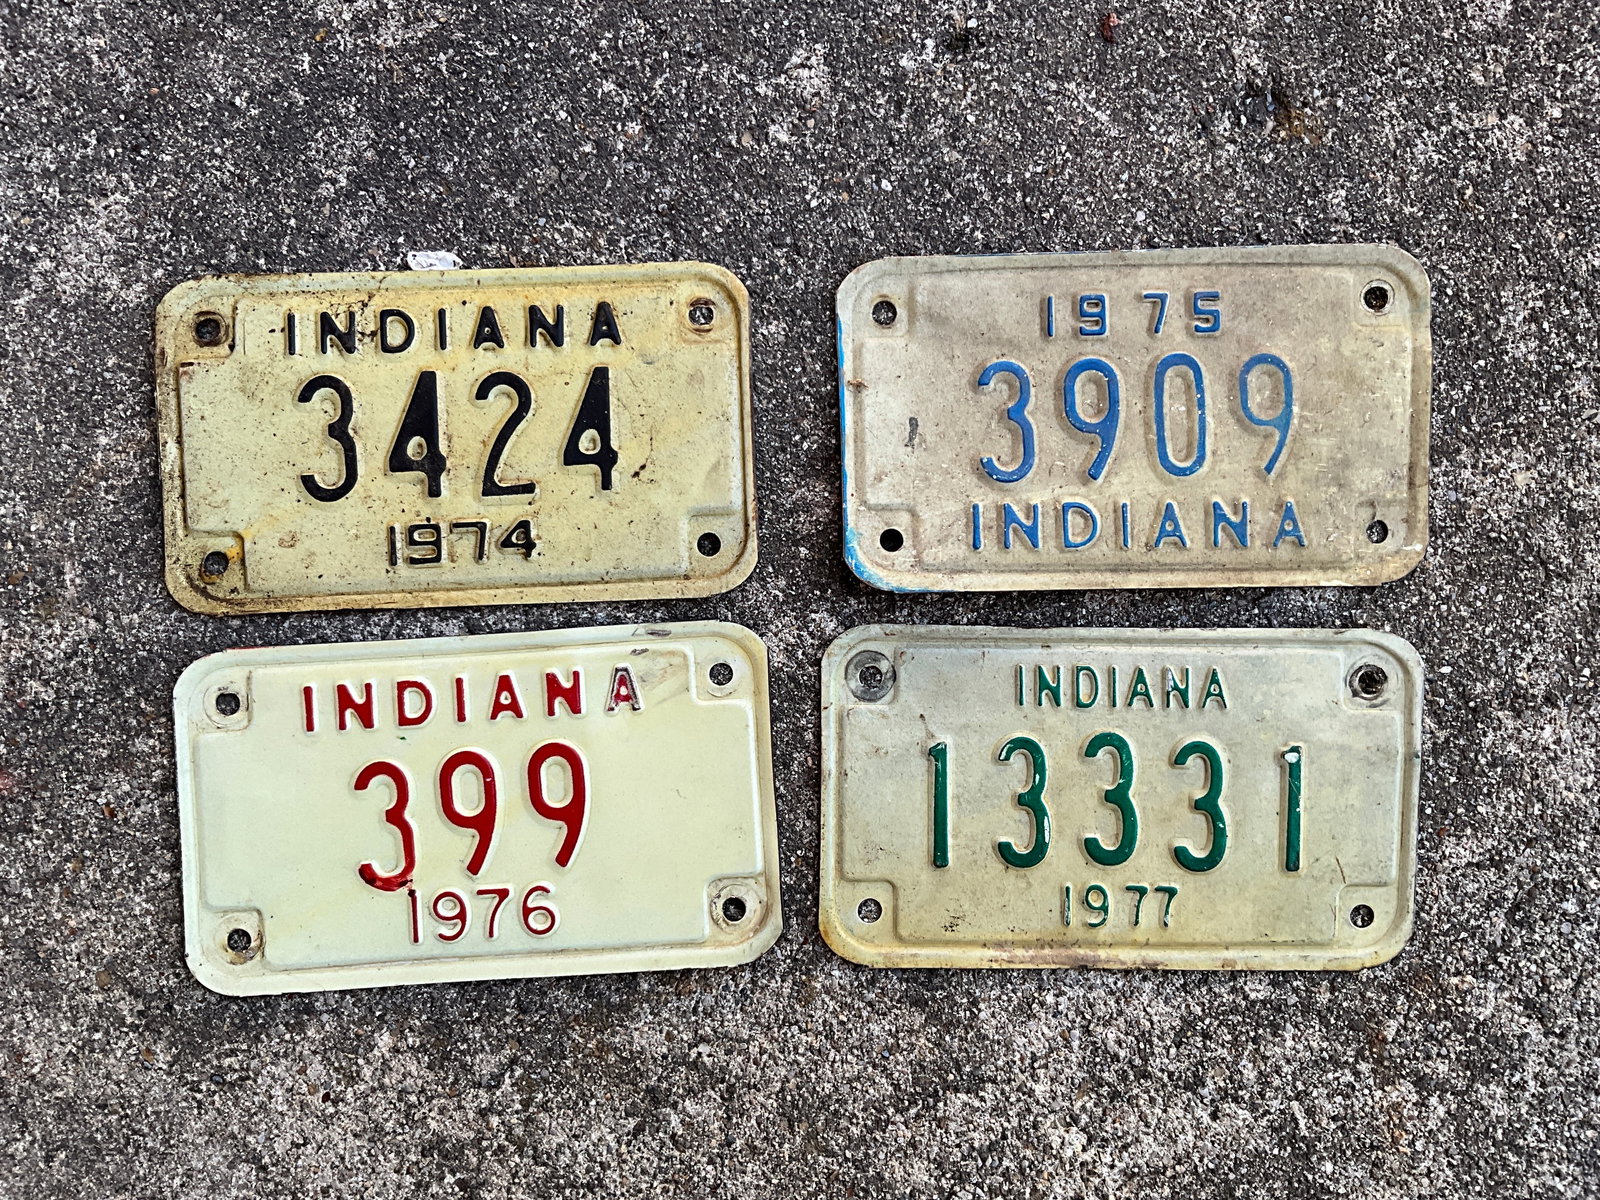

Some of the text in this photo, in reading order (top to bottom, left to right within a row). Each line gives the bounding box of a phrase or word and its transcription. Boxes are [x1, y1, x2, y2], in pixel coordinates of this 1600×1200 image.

[286, 300, 623, 356] INDIANA
[1045, 290, 1221, 337] 1975
[297, 365, 619, 502] 3424
[976, 352, 1294, 483] 3909
[388, 518, 537, 566] 1974
[970, 499, 1306, 550] INDIANA
[301, 665, 641, 733] INDIANA
[1017, 664, 1228, 708] INDIANA
[353, 741, 586, 892] 399
[927, 731, 1303, 873] 13331
[407, 884, 558, 943] 1976
[1063, 883, 1179, 928] 1977
